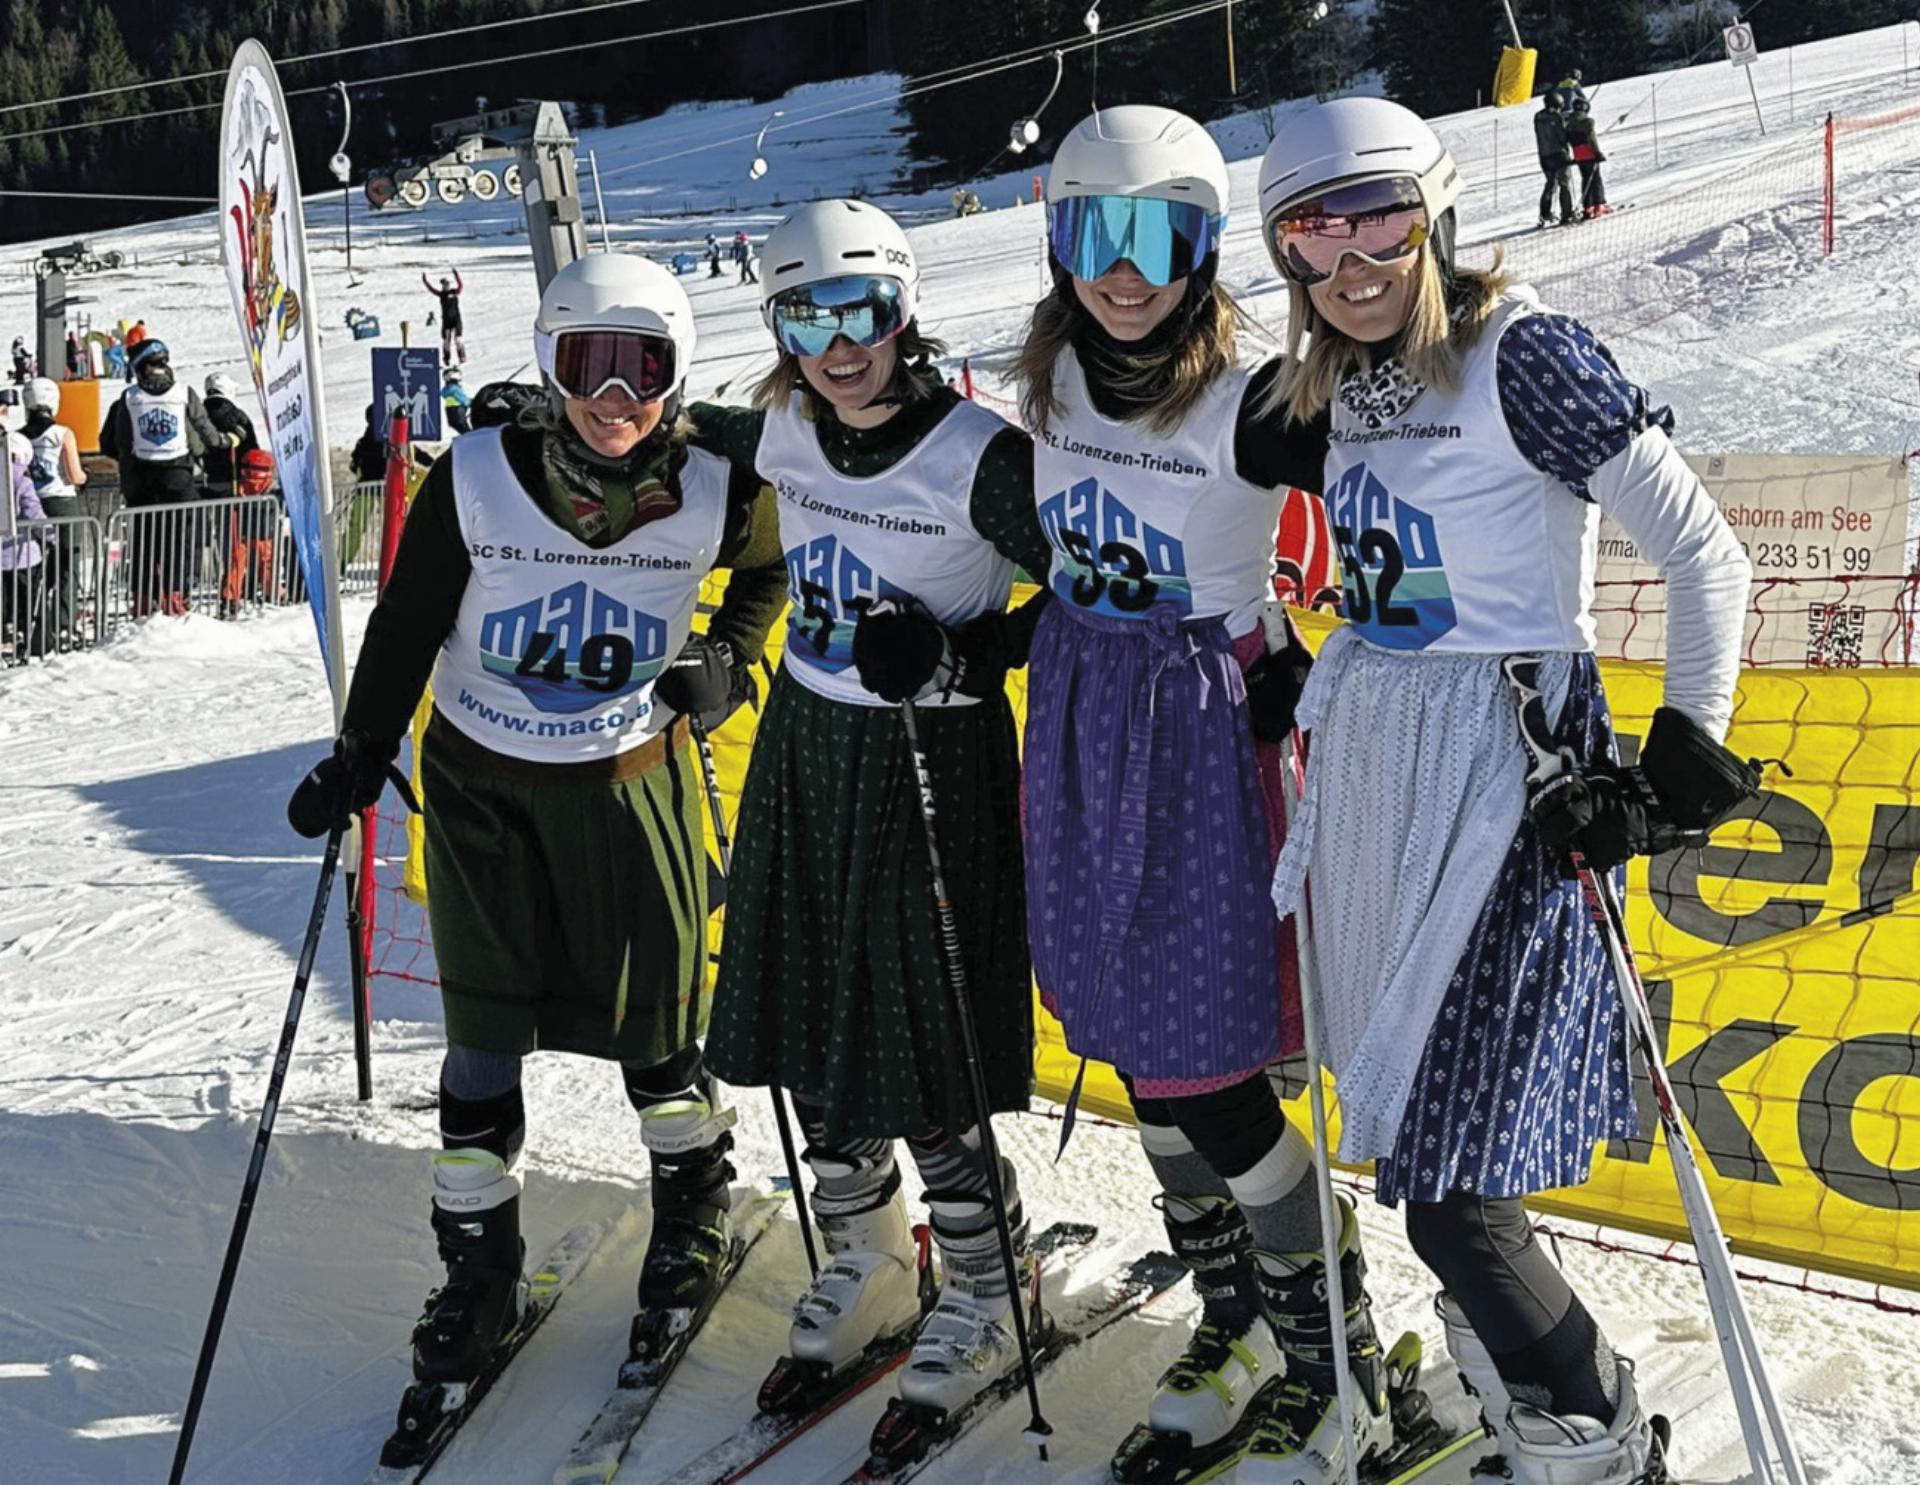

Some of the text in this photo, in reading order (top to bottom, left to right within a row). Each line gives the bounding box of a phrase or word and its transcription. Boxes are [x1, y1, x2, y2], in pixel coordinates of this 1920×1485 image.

[1063, 434, 1207, 478] Lorenzen-Trieben
[801, 494, 946, 536] Lorenzen-Trieben
[1791, 509, 1824, 530] am
[1831, 505, 1872, 532] See
[471, 543, 692, 571] SC St. Lorenzen-Trieben
[1060, 527, 1160, 612] 53
[1334, 526, 1421, 627] 52
[1757, 542, 1798, 569] 233
[1806, 545, 1832, 571] 51
[1843, 546, 1872, 572] 99
[479, 580, 668, 663] maco
[515, 631, 635, 693] 49
[914, 751, 936, 817] LEKI
